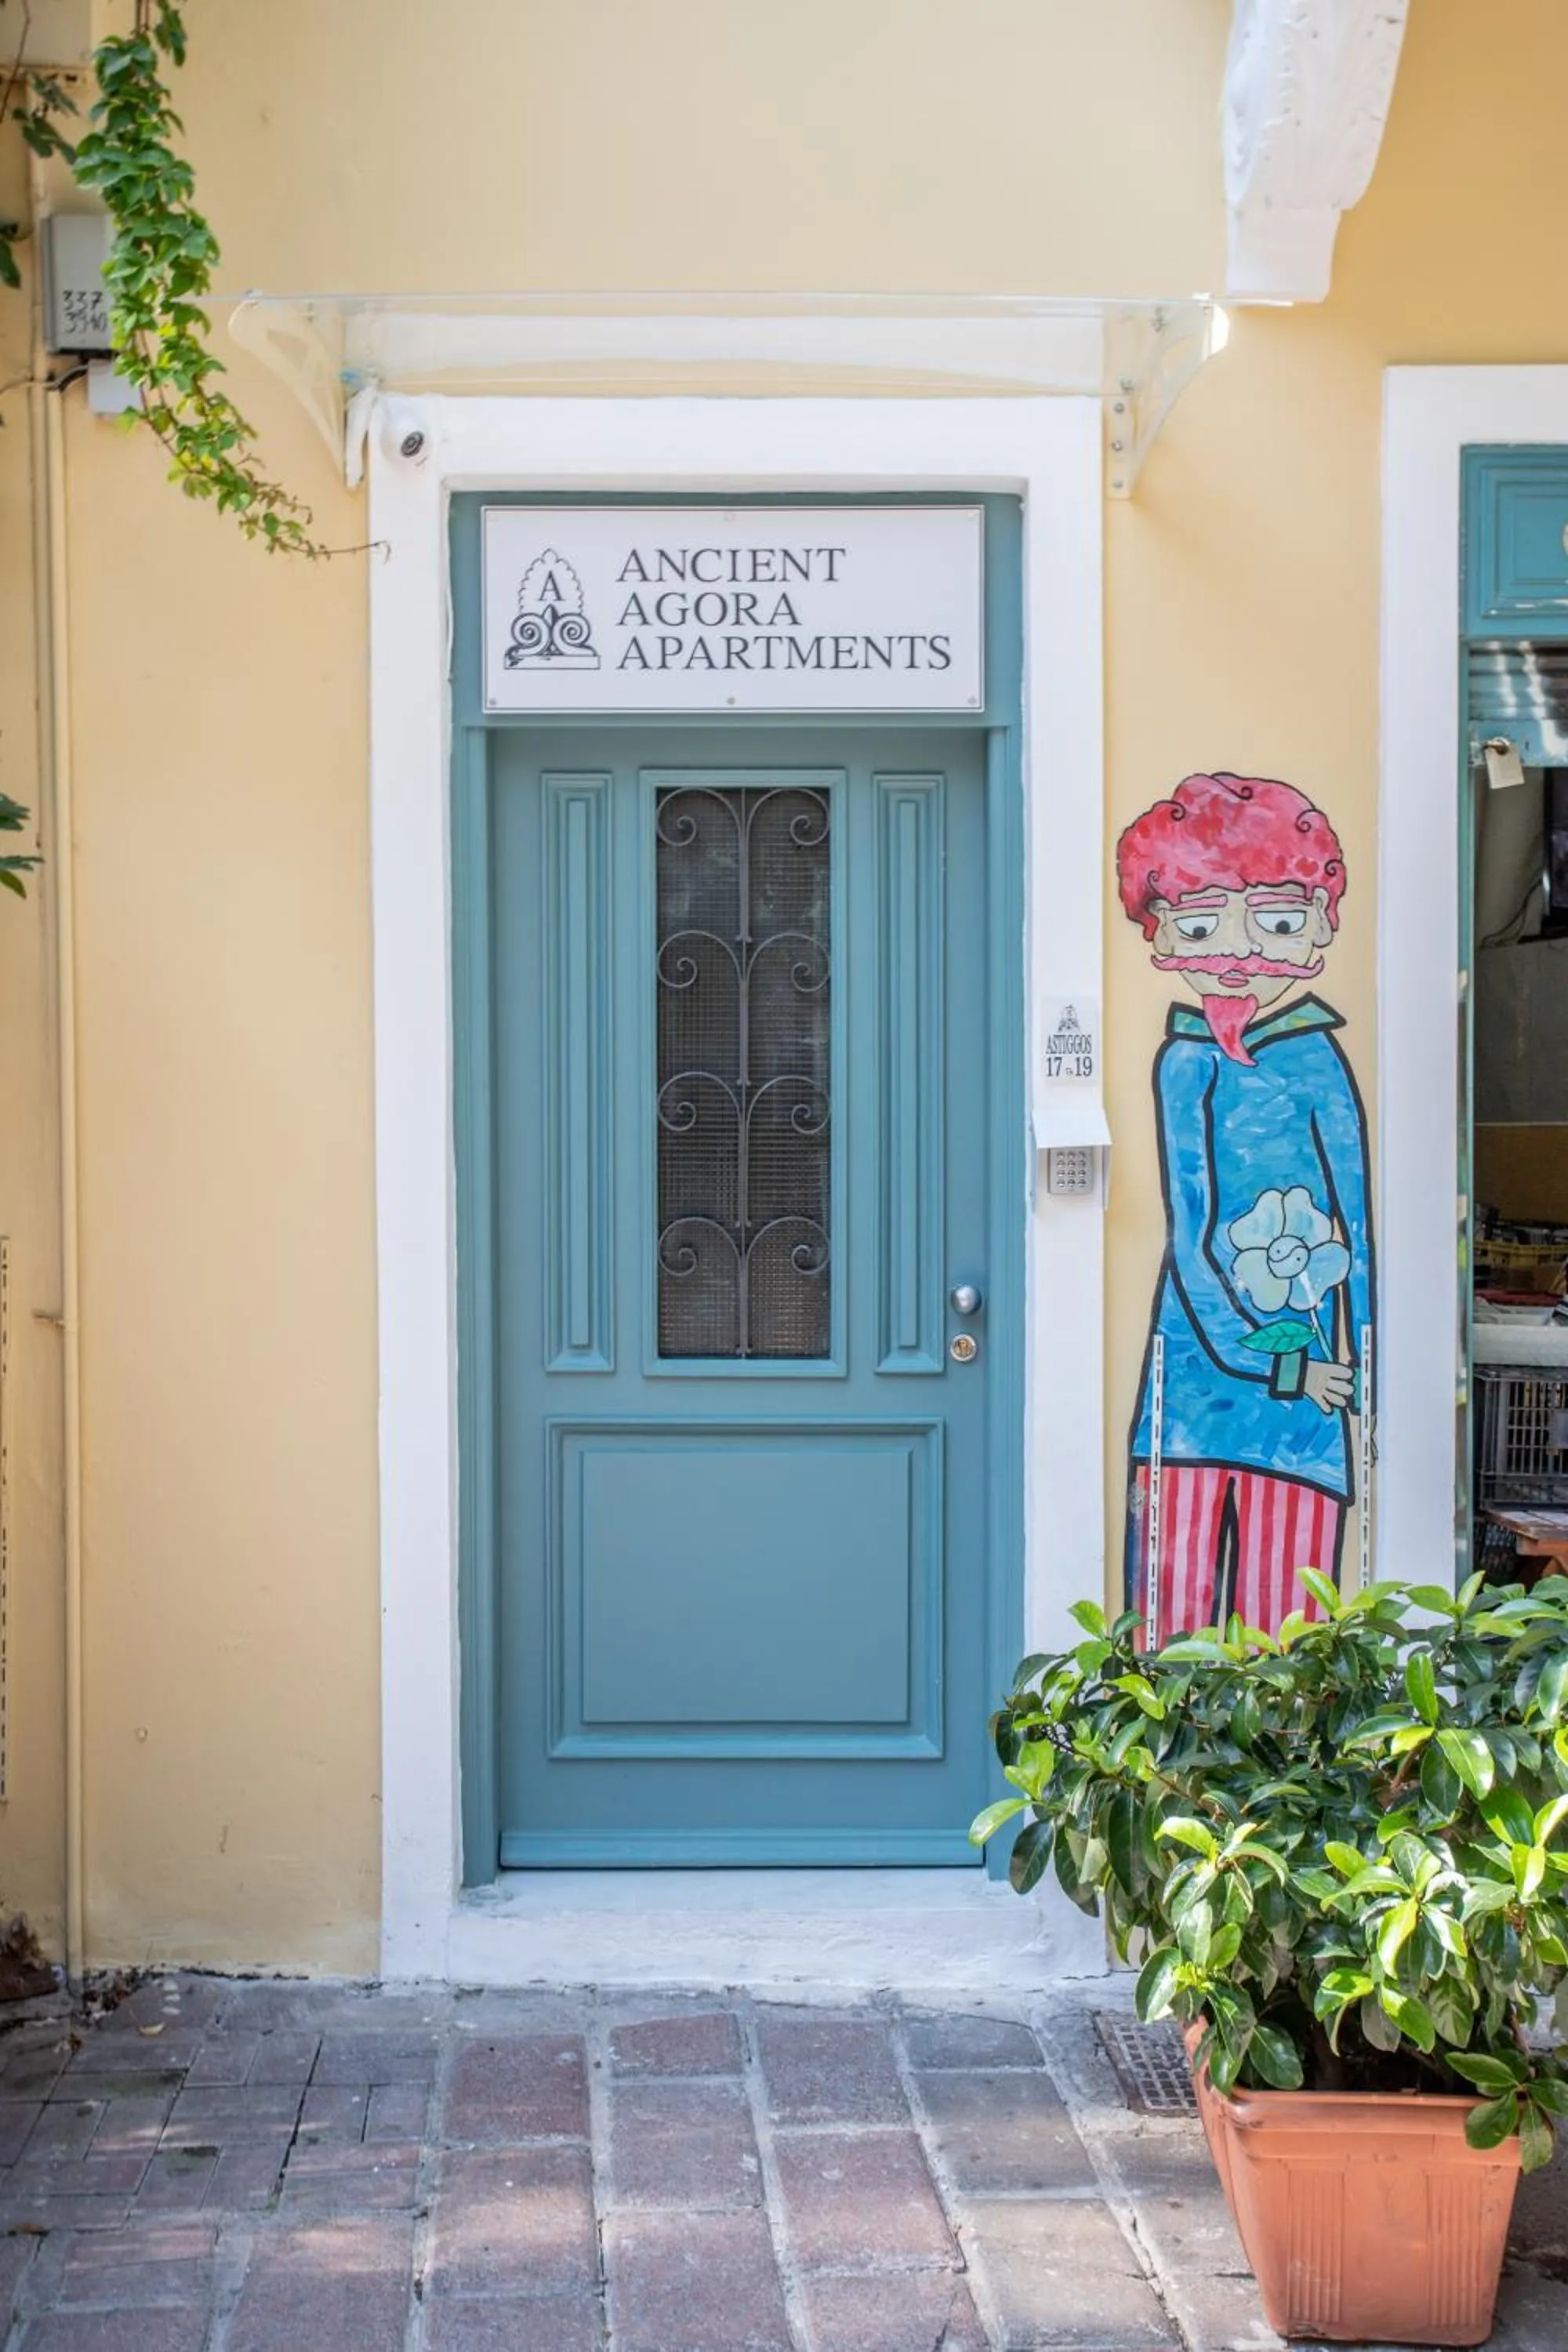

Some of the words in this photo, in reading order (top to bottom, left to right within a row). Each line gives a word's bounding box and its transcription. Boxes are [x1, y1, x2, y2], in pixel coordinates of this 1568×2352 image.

[616, 548, 846, 583] ANCIENT
[538, 570, 565, 601] A
[616, 592, 803, 626] AGORA
[616, 635, 952, 670] APARTMENTS
[1046, 1034, 1092, 1054] ASTIGGOS
[1047, 1056, 1062, 1077] 17
[1075, 1056, 1092, 1077] 19
